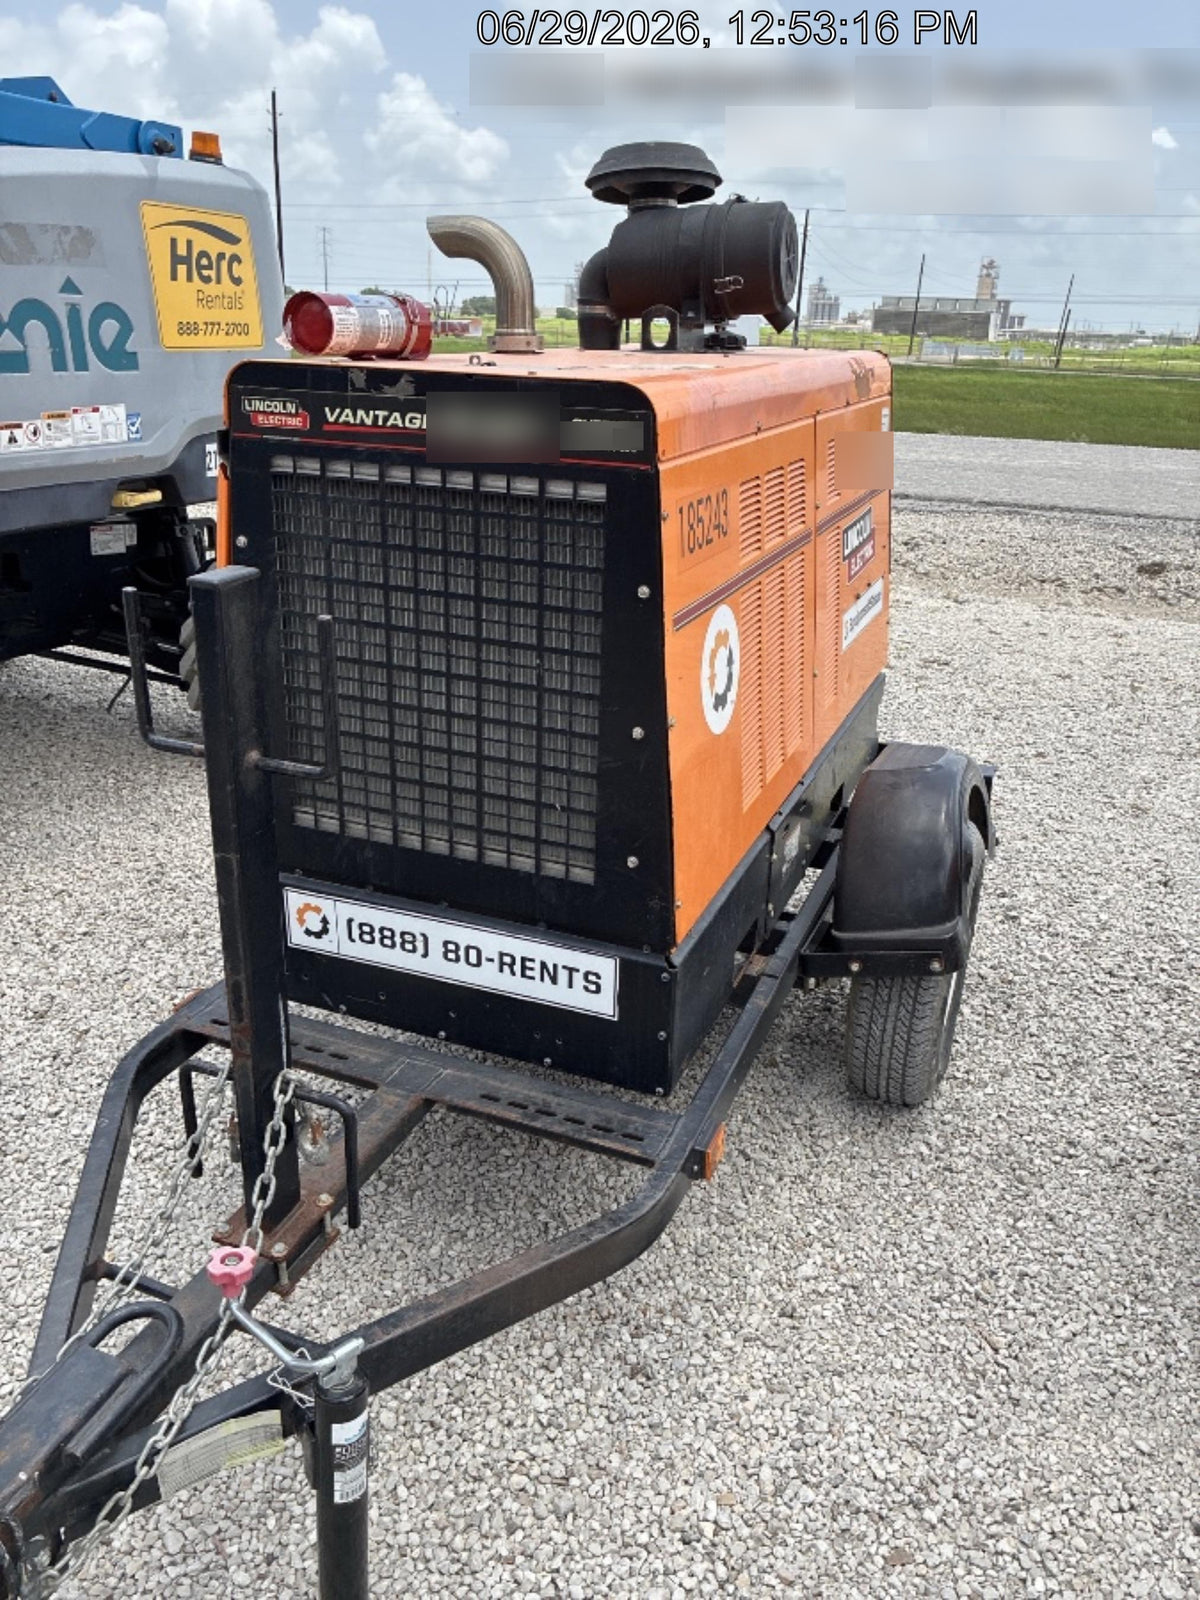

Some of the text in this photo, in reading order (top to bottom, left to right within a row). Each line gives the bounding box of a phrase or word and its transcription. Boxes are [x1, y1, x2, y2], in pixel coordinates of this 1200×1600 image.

[170, 236, 244, 287] Herc
[196, 289, 244, 310] Rentals
[177, 321, 250, 336] 888-777-2700
[244, 399, 297, 414] LINCOLN
[257, 413, 303, 427] ELECTRIC
[324, 407, 427, 430] VANTAG
[678, 488, 728, 558] 185243
[346, 916, 603, 995] (888) 80-RENTS
